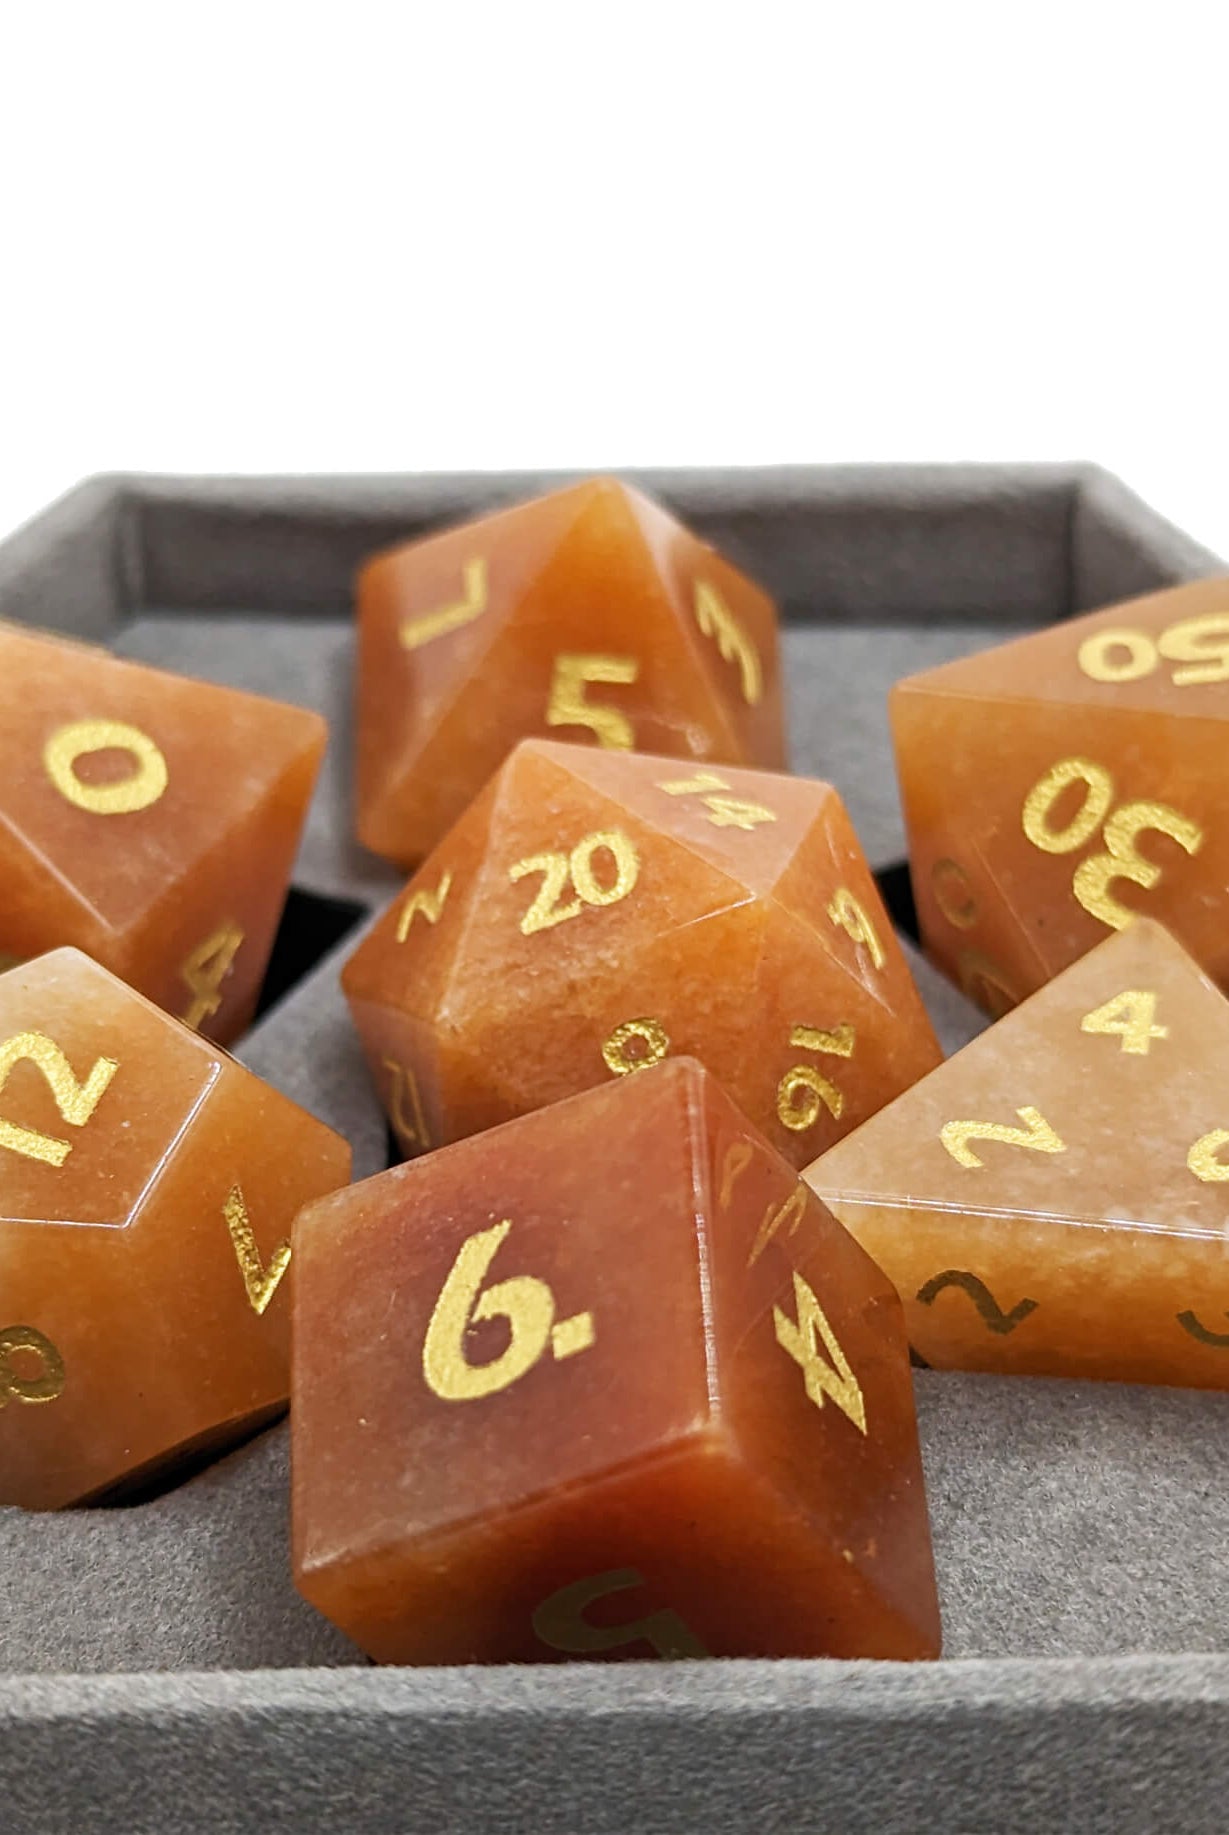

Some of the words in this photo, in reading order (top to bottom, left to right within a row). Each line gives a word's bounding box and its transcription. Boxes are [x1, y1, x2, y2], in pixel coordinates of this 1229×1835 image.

[547, 653, 639, 752] 5
[43, 719, 168, 815] 0
[509, 830, 641, 936] 20
[1022, 756, 1203, 931] 30
[1080, 990, 1170, 1056] 4
[940, 1105, 1068, 1169] 2
[916, 1269, 1038, 1335] 2
[772, 1270, 868, 1437] 4
